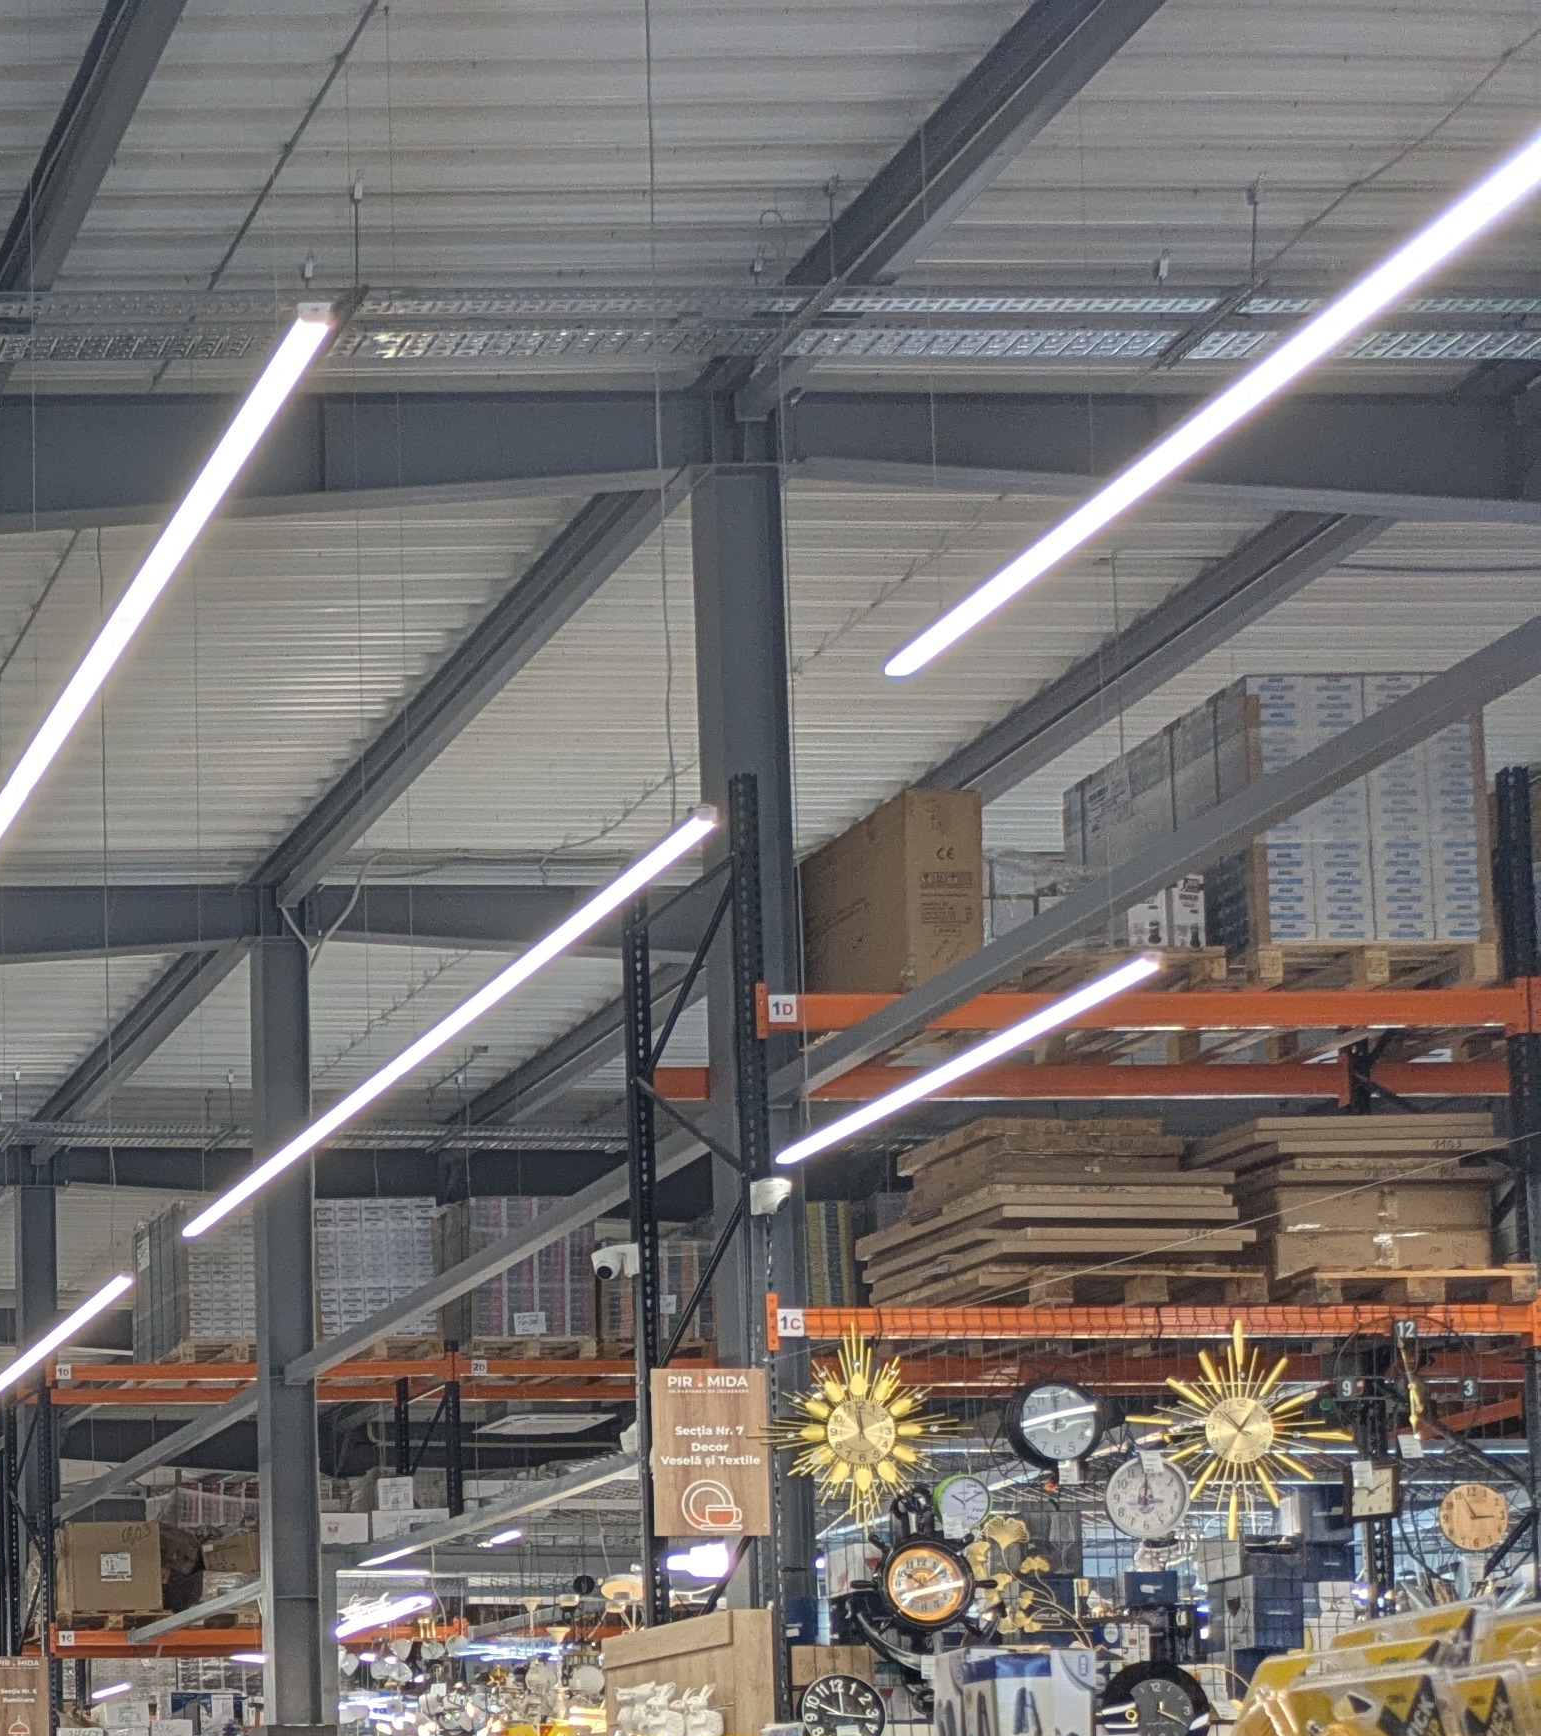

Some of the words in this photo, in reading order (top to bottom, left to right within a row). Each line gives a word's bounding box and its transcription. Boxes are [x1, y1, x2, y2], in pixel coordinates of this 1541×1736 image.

[771, 1001, 794, 1016] 1D
[779, 1315, 801, 1331] 1C
[1395, 1321, 1414, 1339] 12
[57, 1367, 70, 1376] 1D
[1340, 1380, 1351, 1398] 9
[1463, 1380, 1473, 1398] 3
[716, 1425, 734, 1436] Nr.
[736, 1425, 745, 1436] 7
[690, 1441, 729, 1453] Decor
[717, 1455, 761, 1467] Textile
